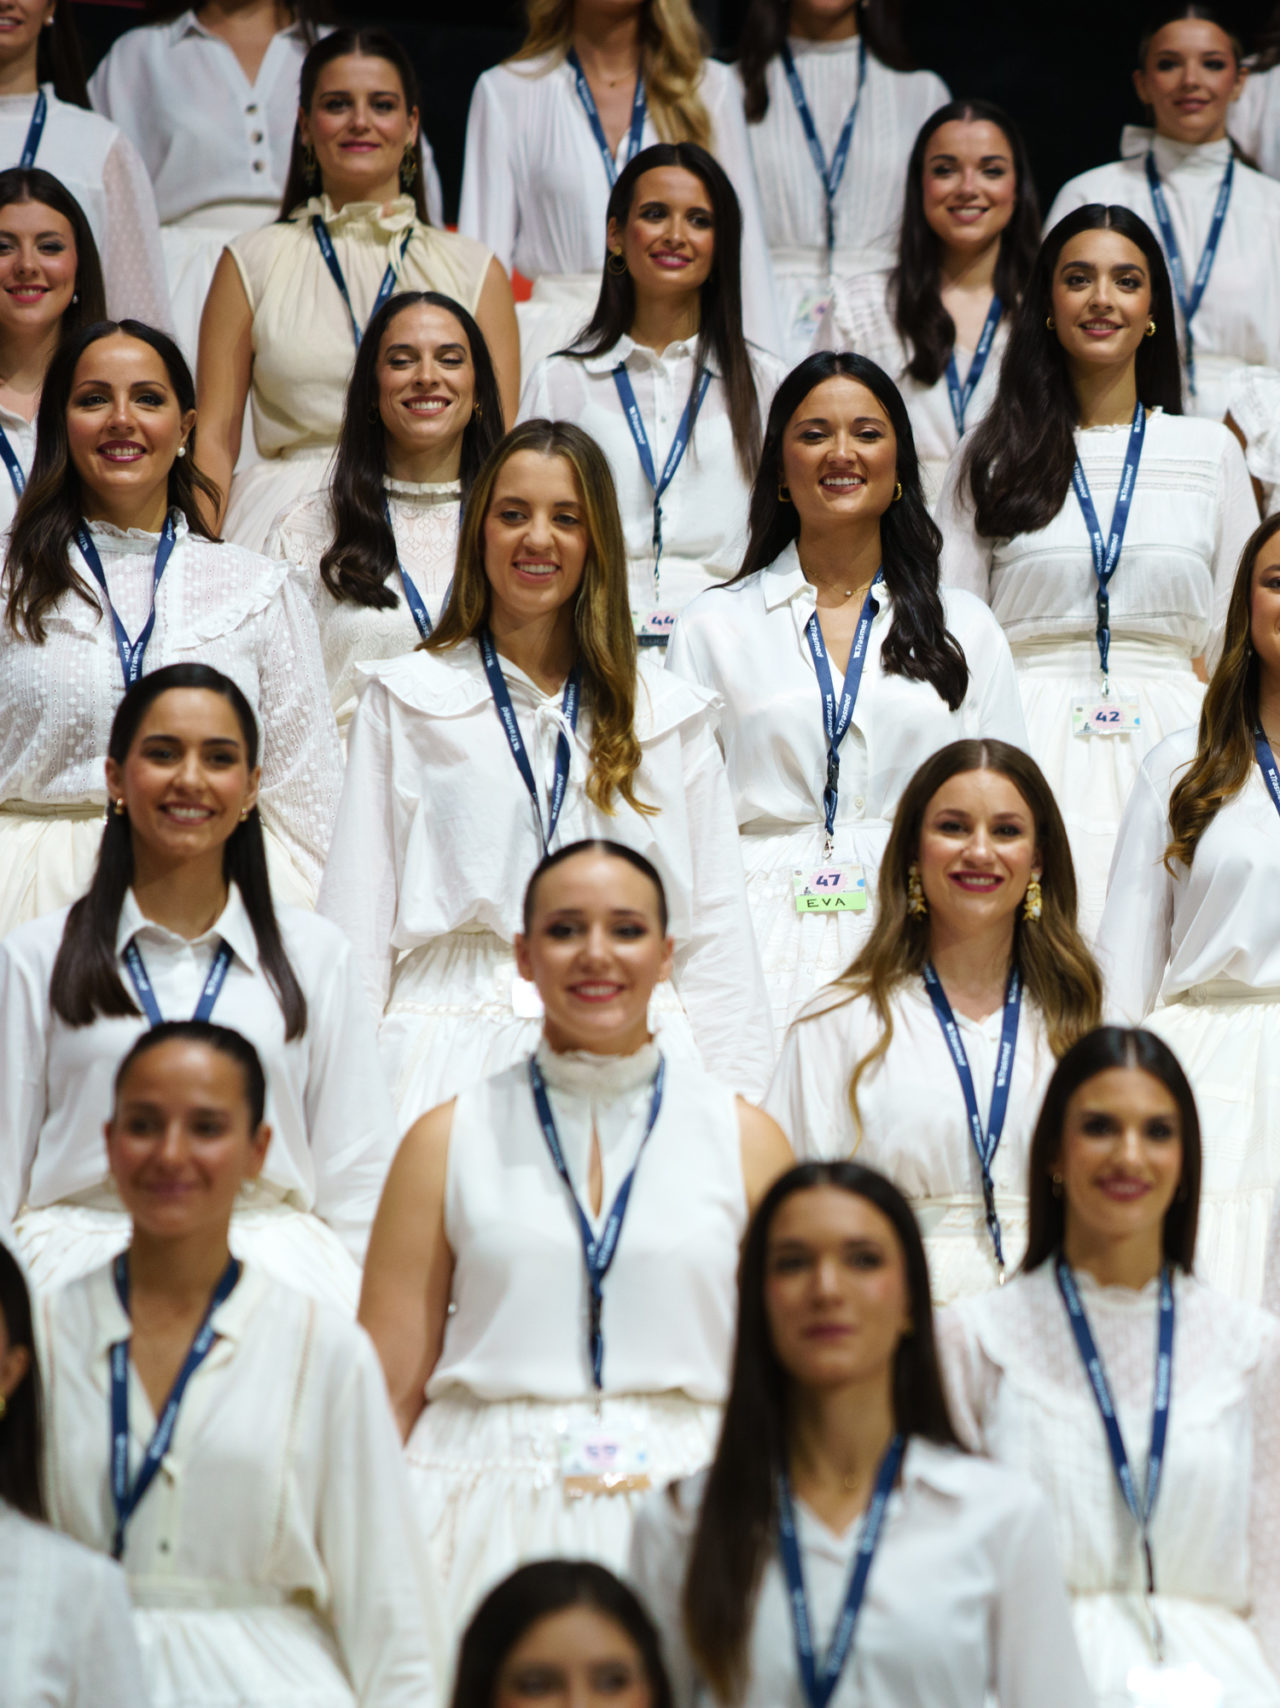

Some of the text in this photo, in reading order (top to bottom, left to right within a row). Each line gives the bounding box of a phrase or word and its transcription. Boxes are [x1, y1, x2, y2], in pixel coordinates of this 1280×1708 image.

[1122, 464, 1134, 492] Trasmed
[856, 619, 868, 651] Trasmed
[131, 642, 143, 674] Trasmed
[565, 683, 576, 718] Trasmed
[840, 692, 852, 728] Trasmed
[1095, 711, 1120, 722] 42
[501, 706, 518, 743] Trasmed
[554, 773, 564, 809] Trasmed
[816, 874, 841, 886] 47
[806, 897, 846, 908] EVA
